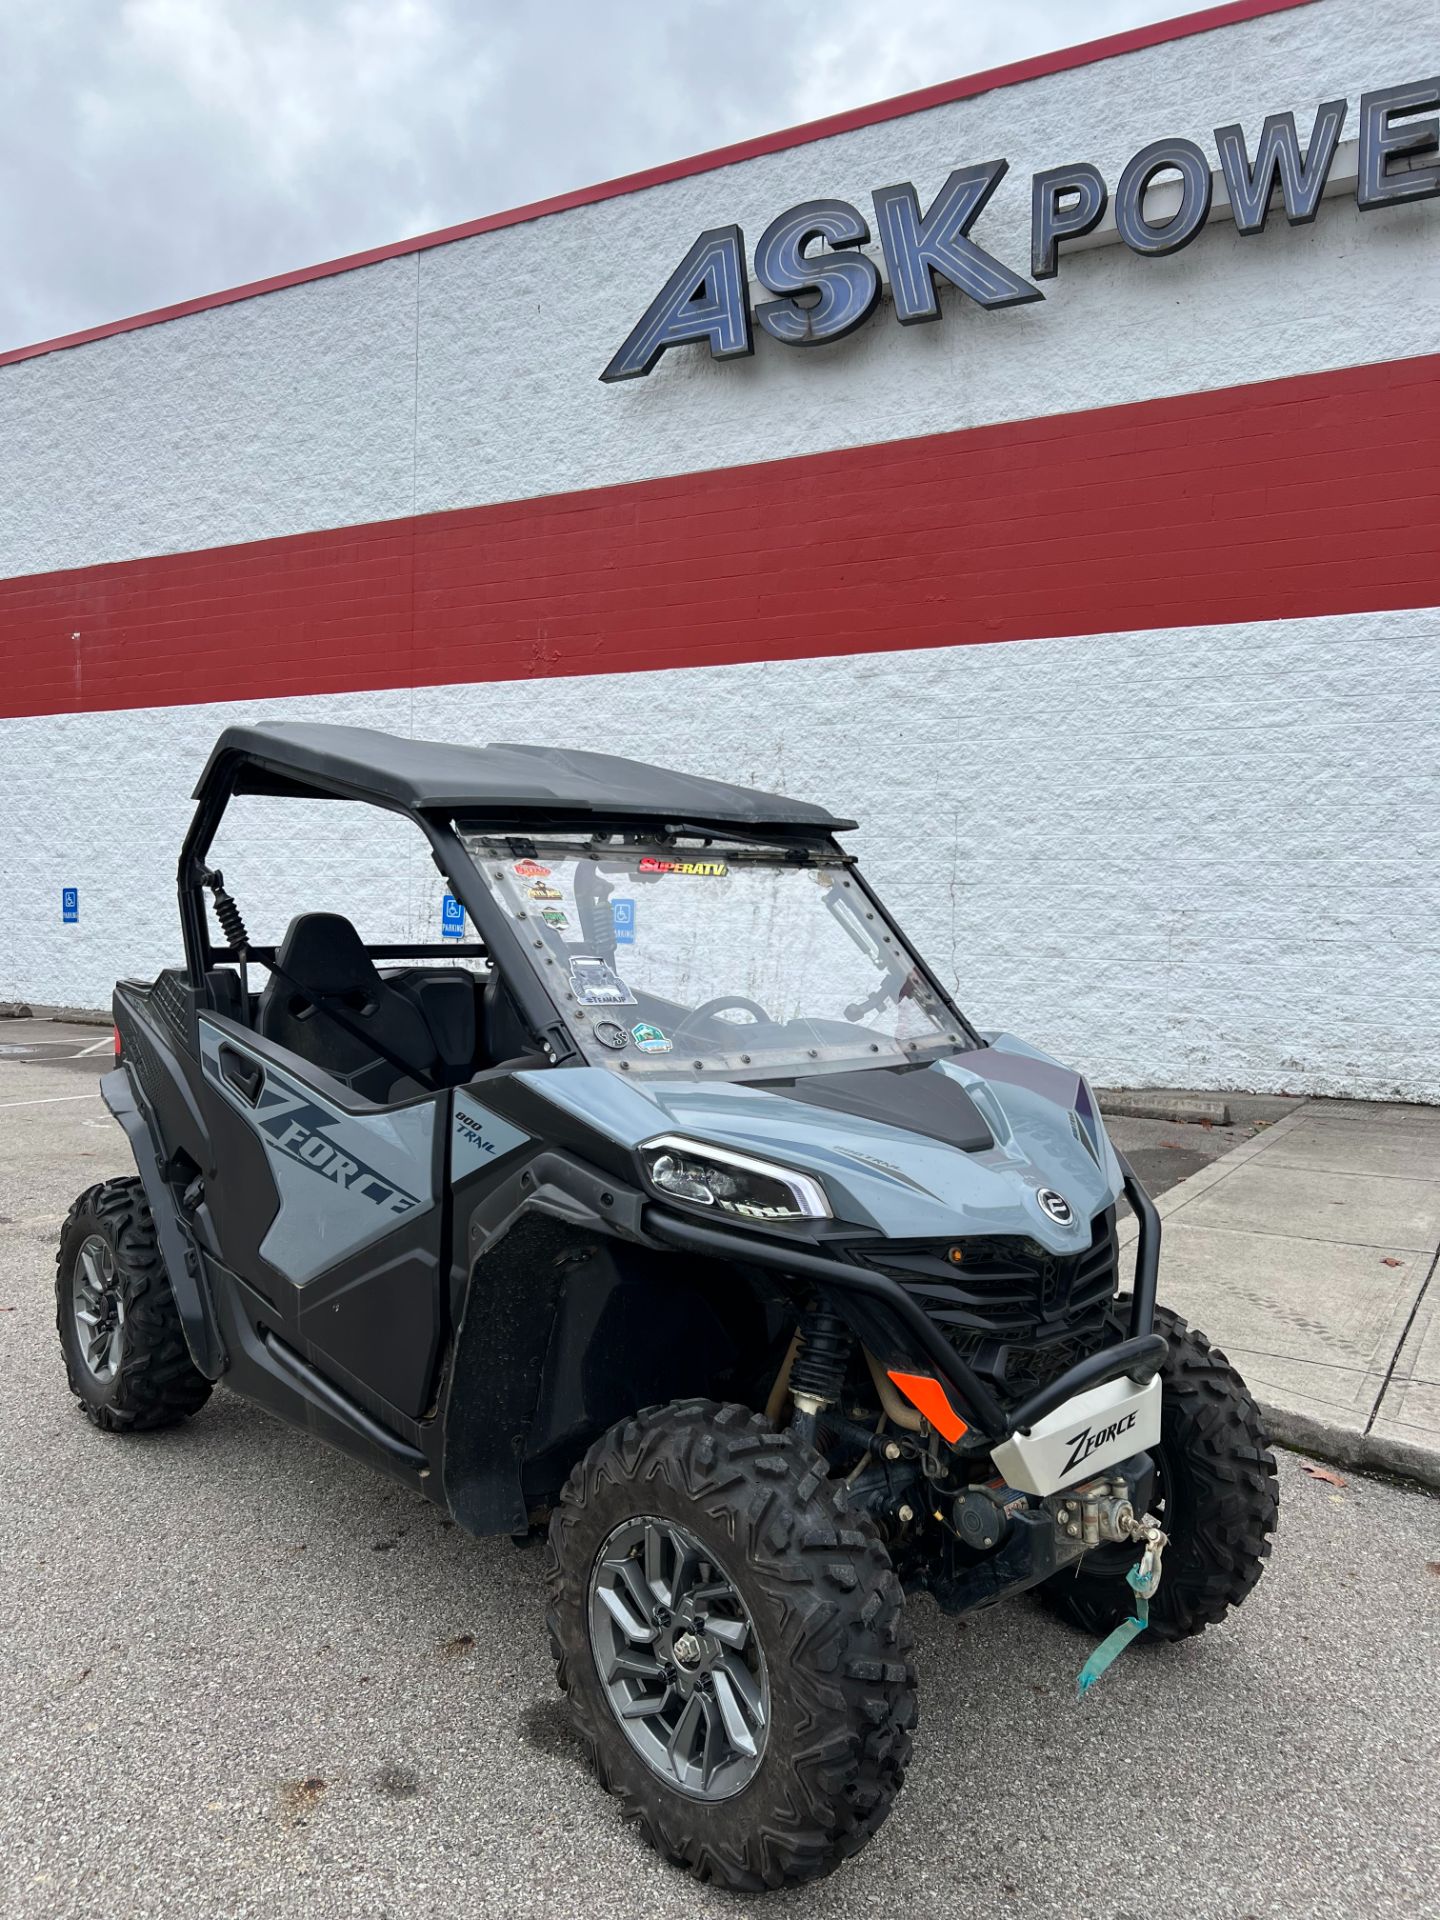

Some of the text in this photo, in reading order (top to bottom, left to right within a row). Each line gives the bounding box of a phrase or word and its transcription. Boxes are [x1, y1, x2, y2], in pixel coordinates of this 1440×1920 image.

[599, 77, 1440, 384] ASK POWE
[639, 857, 725, 876] SUPERATV
[442, 923, 463, 932] PARKING
[455, 1111, 483, 1131] 800
[456, 1123, 496, 1155] TRAIL
